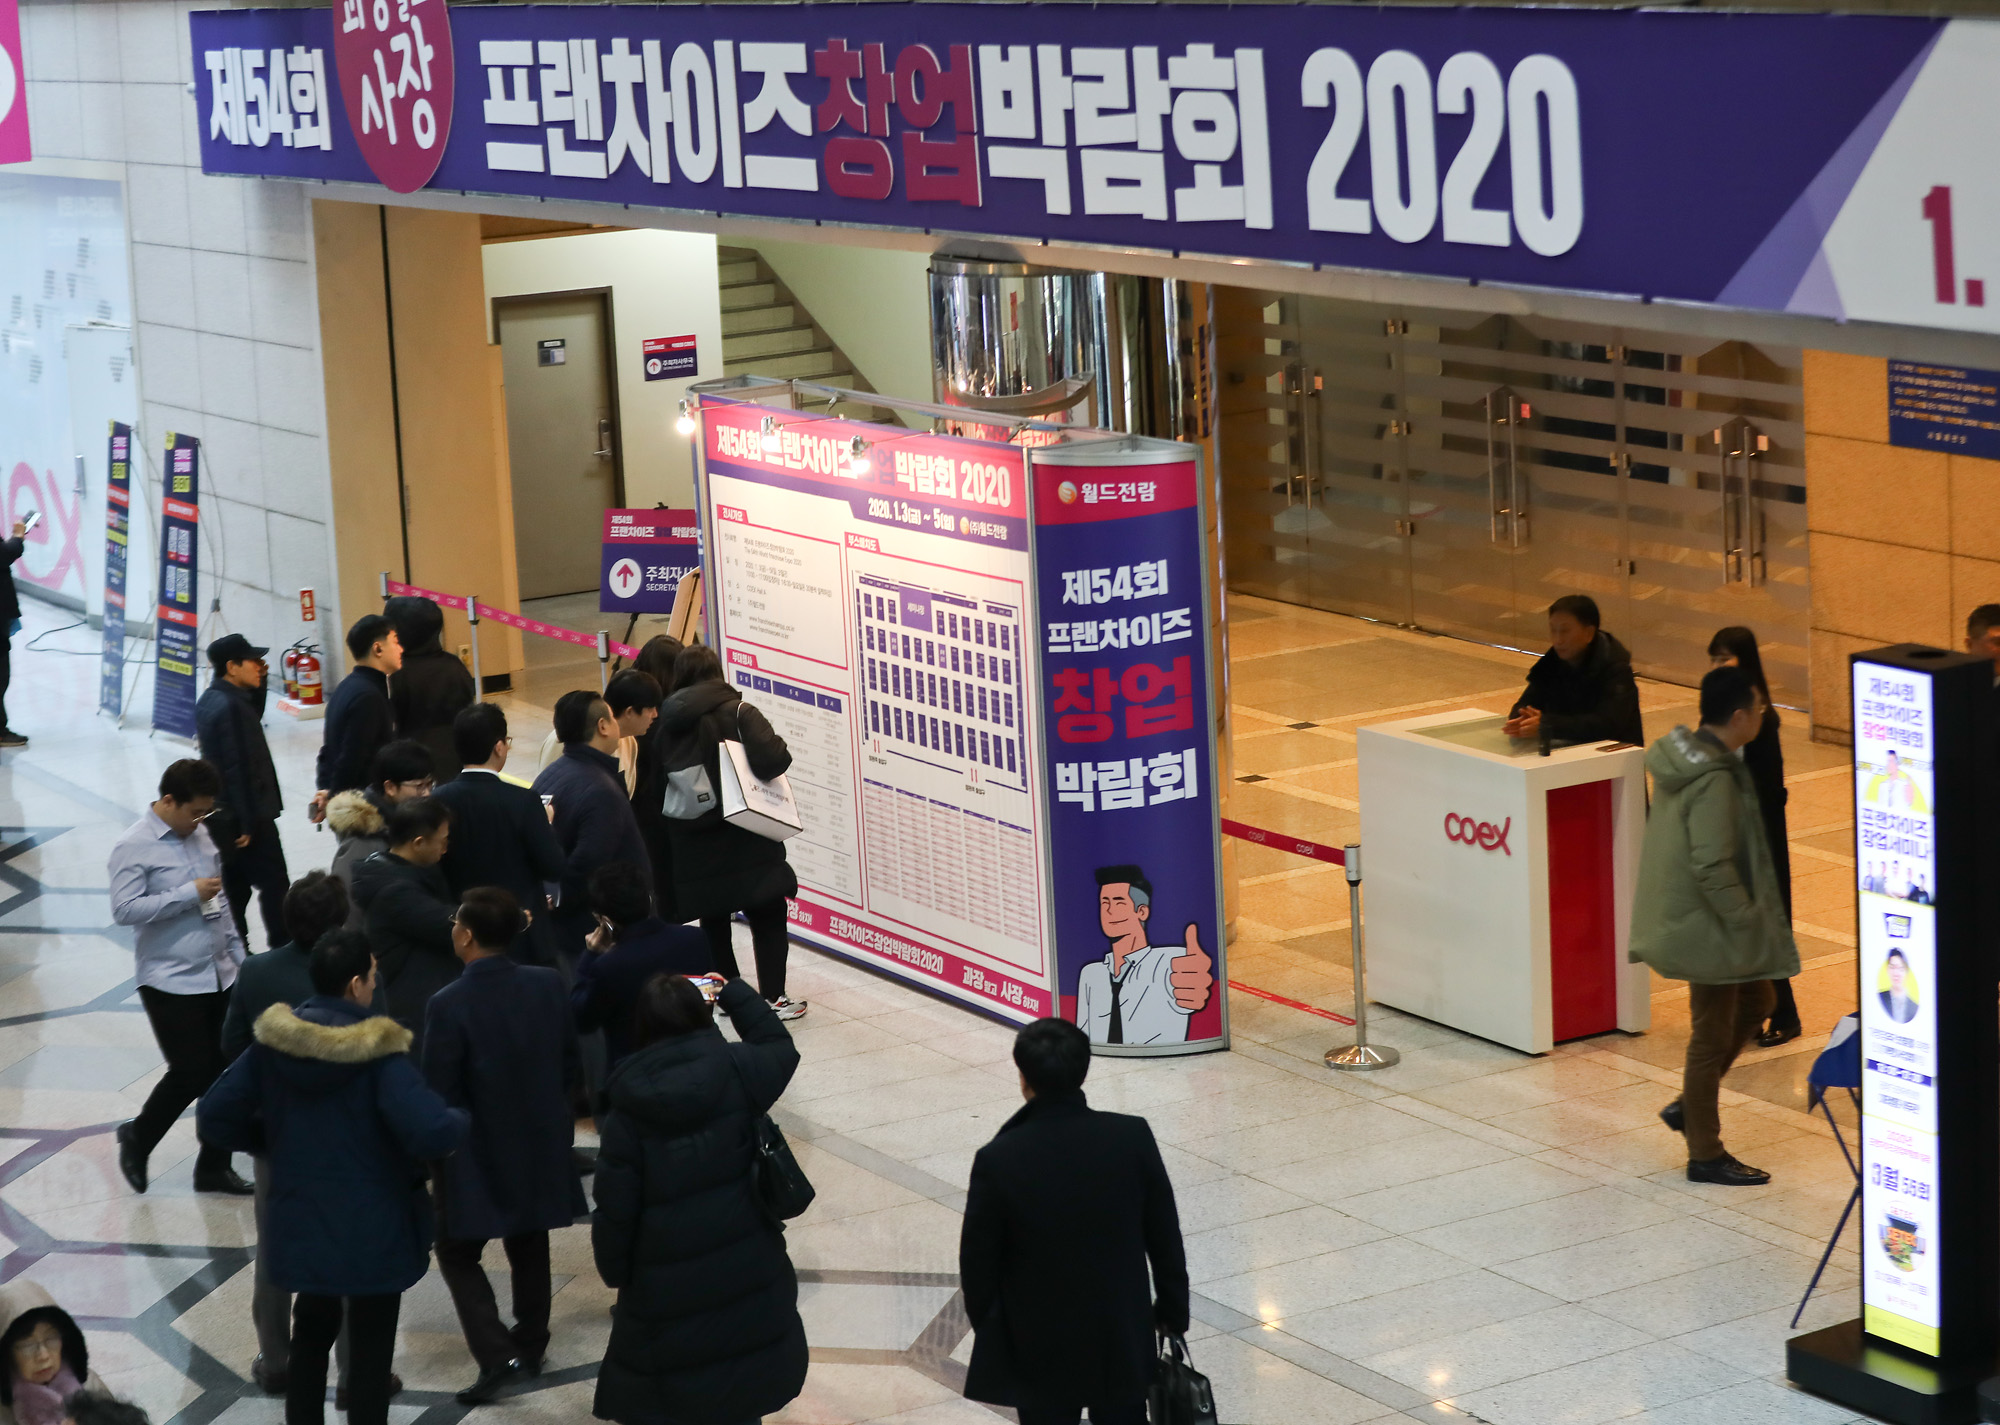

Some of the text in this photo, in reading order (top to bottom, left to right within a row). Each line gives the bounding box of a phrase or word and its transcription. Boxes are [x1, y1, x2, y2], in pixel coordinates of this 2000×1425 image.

[361, 15, 437, 150] 사장
[204, 46, 332, 151] 제54회
[1300, 46, 1585, 257] 2020
[716, 425, 762, 461] 제54회
[960, 461, 1011, 508] 2020
[868, 497, 893, 519] 2020.
[1081, 481, 1157, 503] 월드전람
[1061, 559, 1169, 606] 제54회
[1047, 607, 1193, 654] 프랜차이즈
[1052, 655, 1195, 744] 창업
[1055, 747, 1199, 813] 박람회
[1296, 843, 1315, 855] coex
[1444, 812, 1511, 856] coex
[962, 965, 985, 990] 과장
[1000, 980, 1023, 1006] 사장
